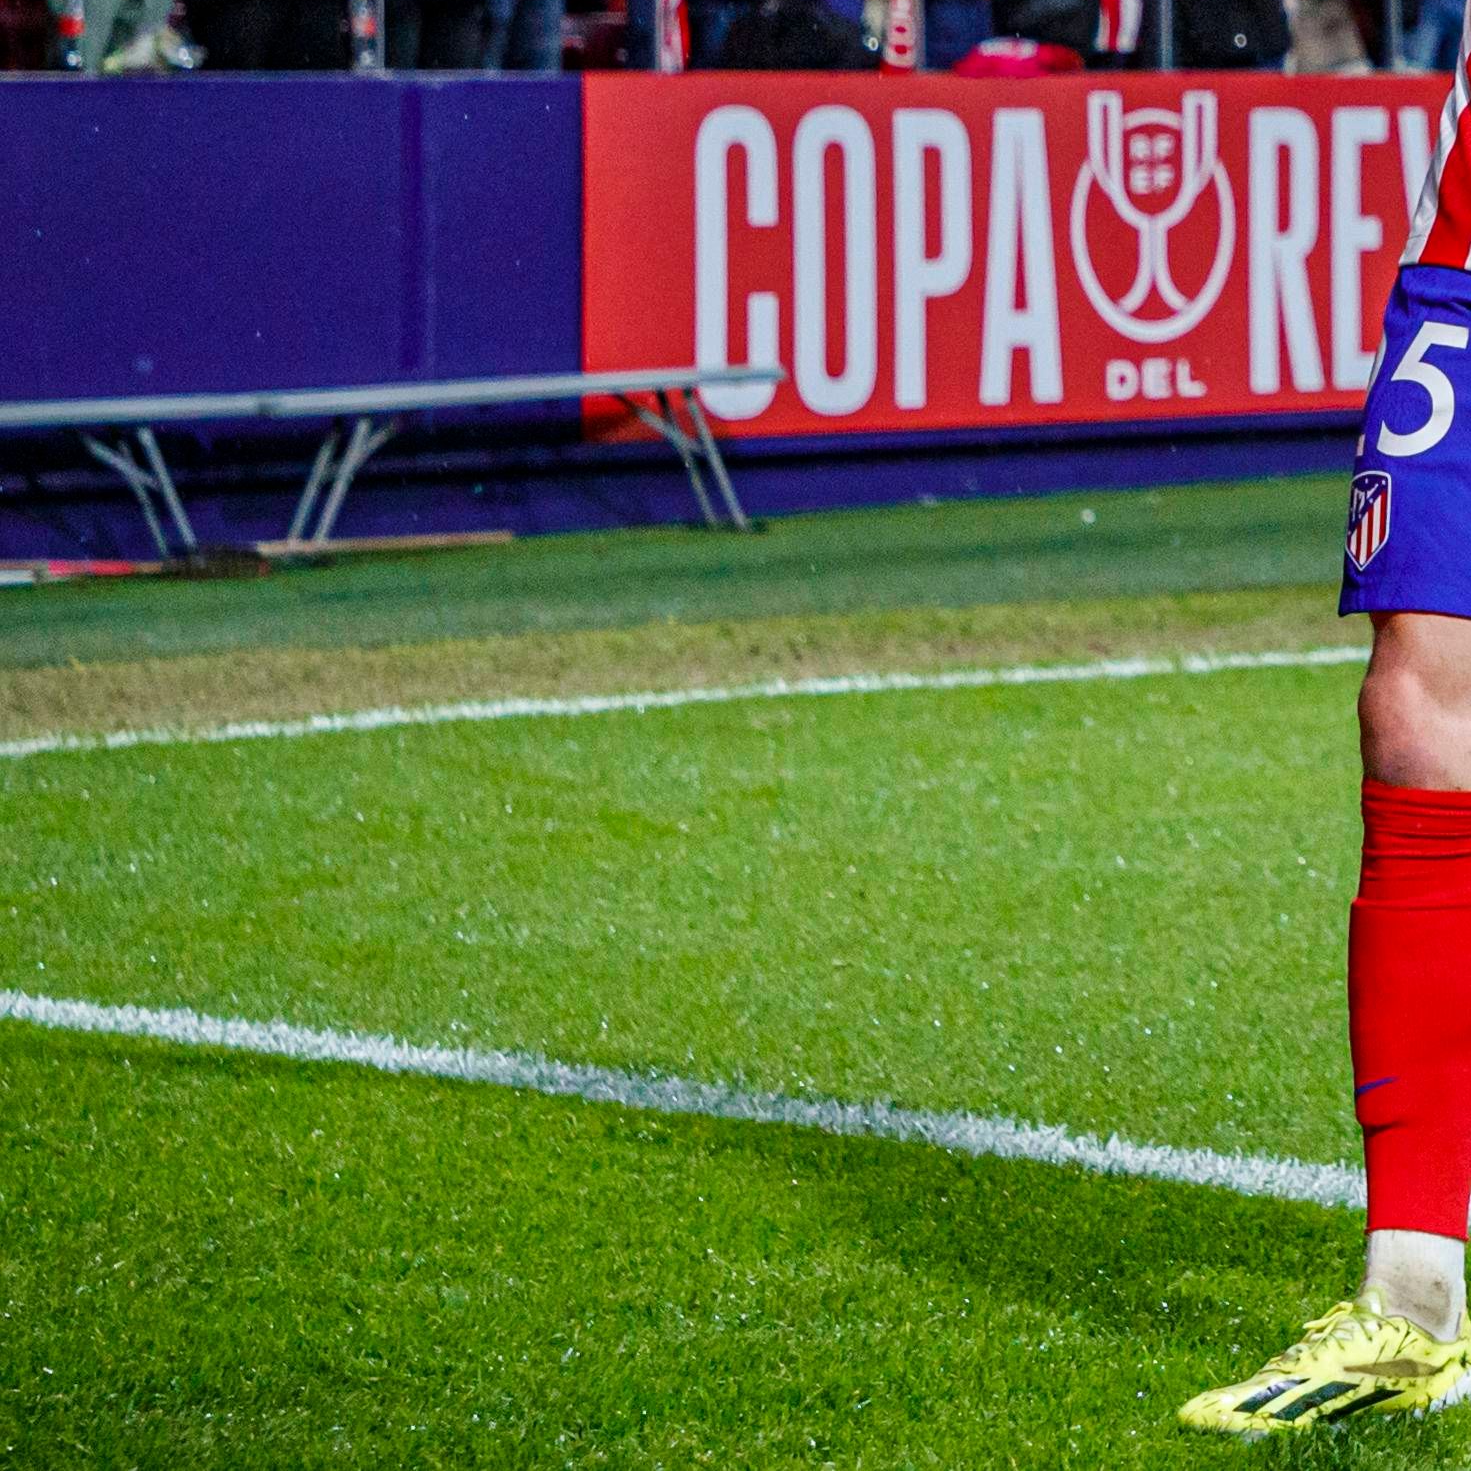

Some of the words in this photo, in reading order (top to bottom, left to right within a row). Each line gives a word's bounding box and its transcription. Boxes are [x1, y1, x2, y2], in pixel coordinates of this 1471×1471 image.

[695, 105, 1064, 421] COPA
[1105, 356, 1208, 401] DEL
[1376, 321, 1469, 457] 5
